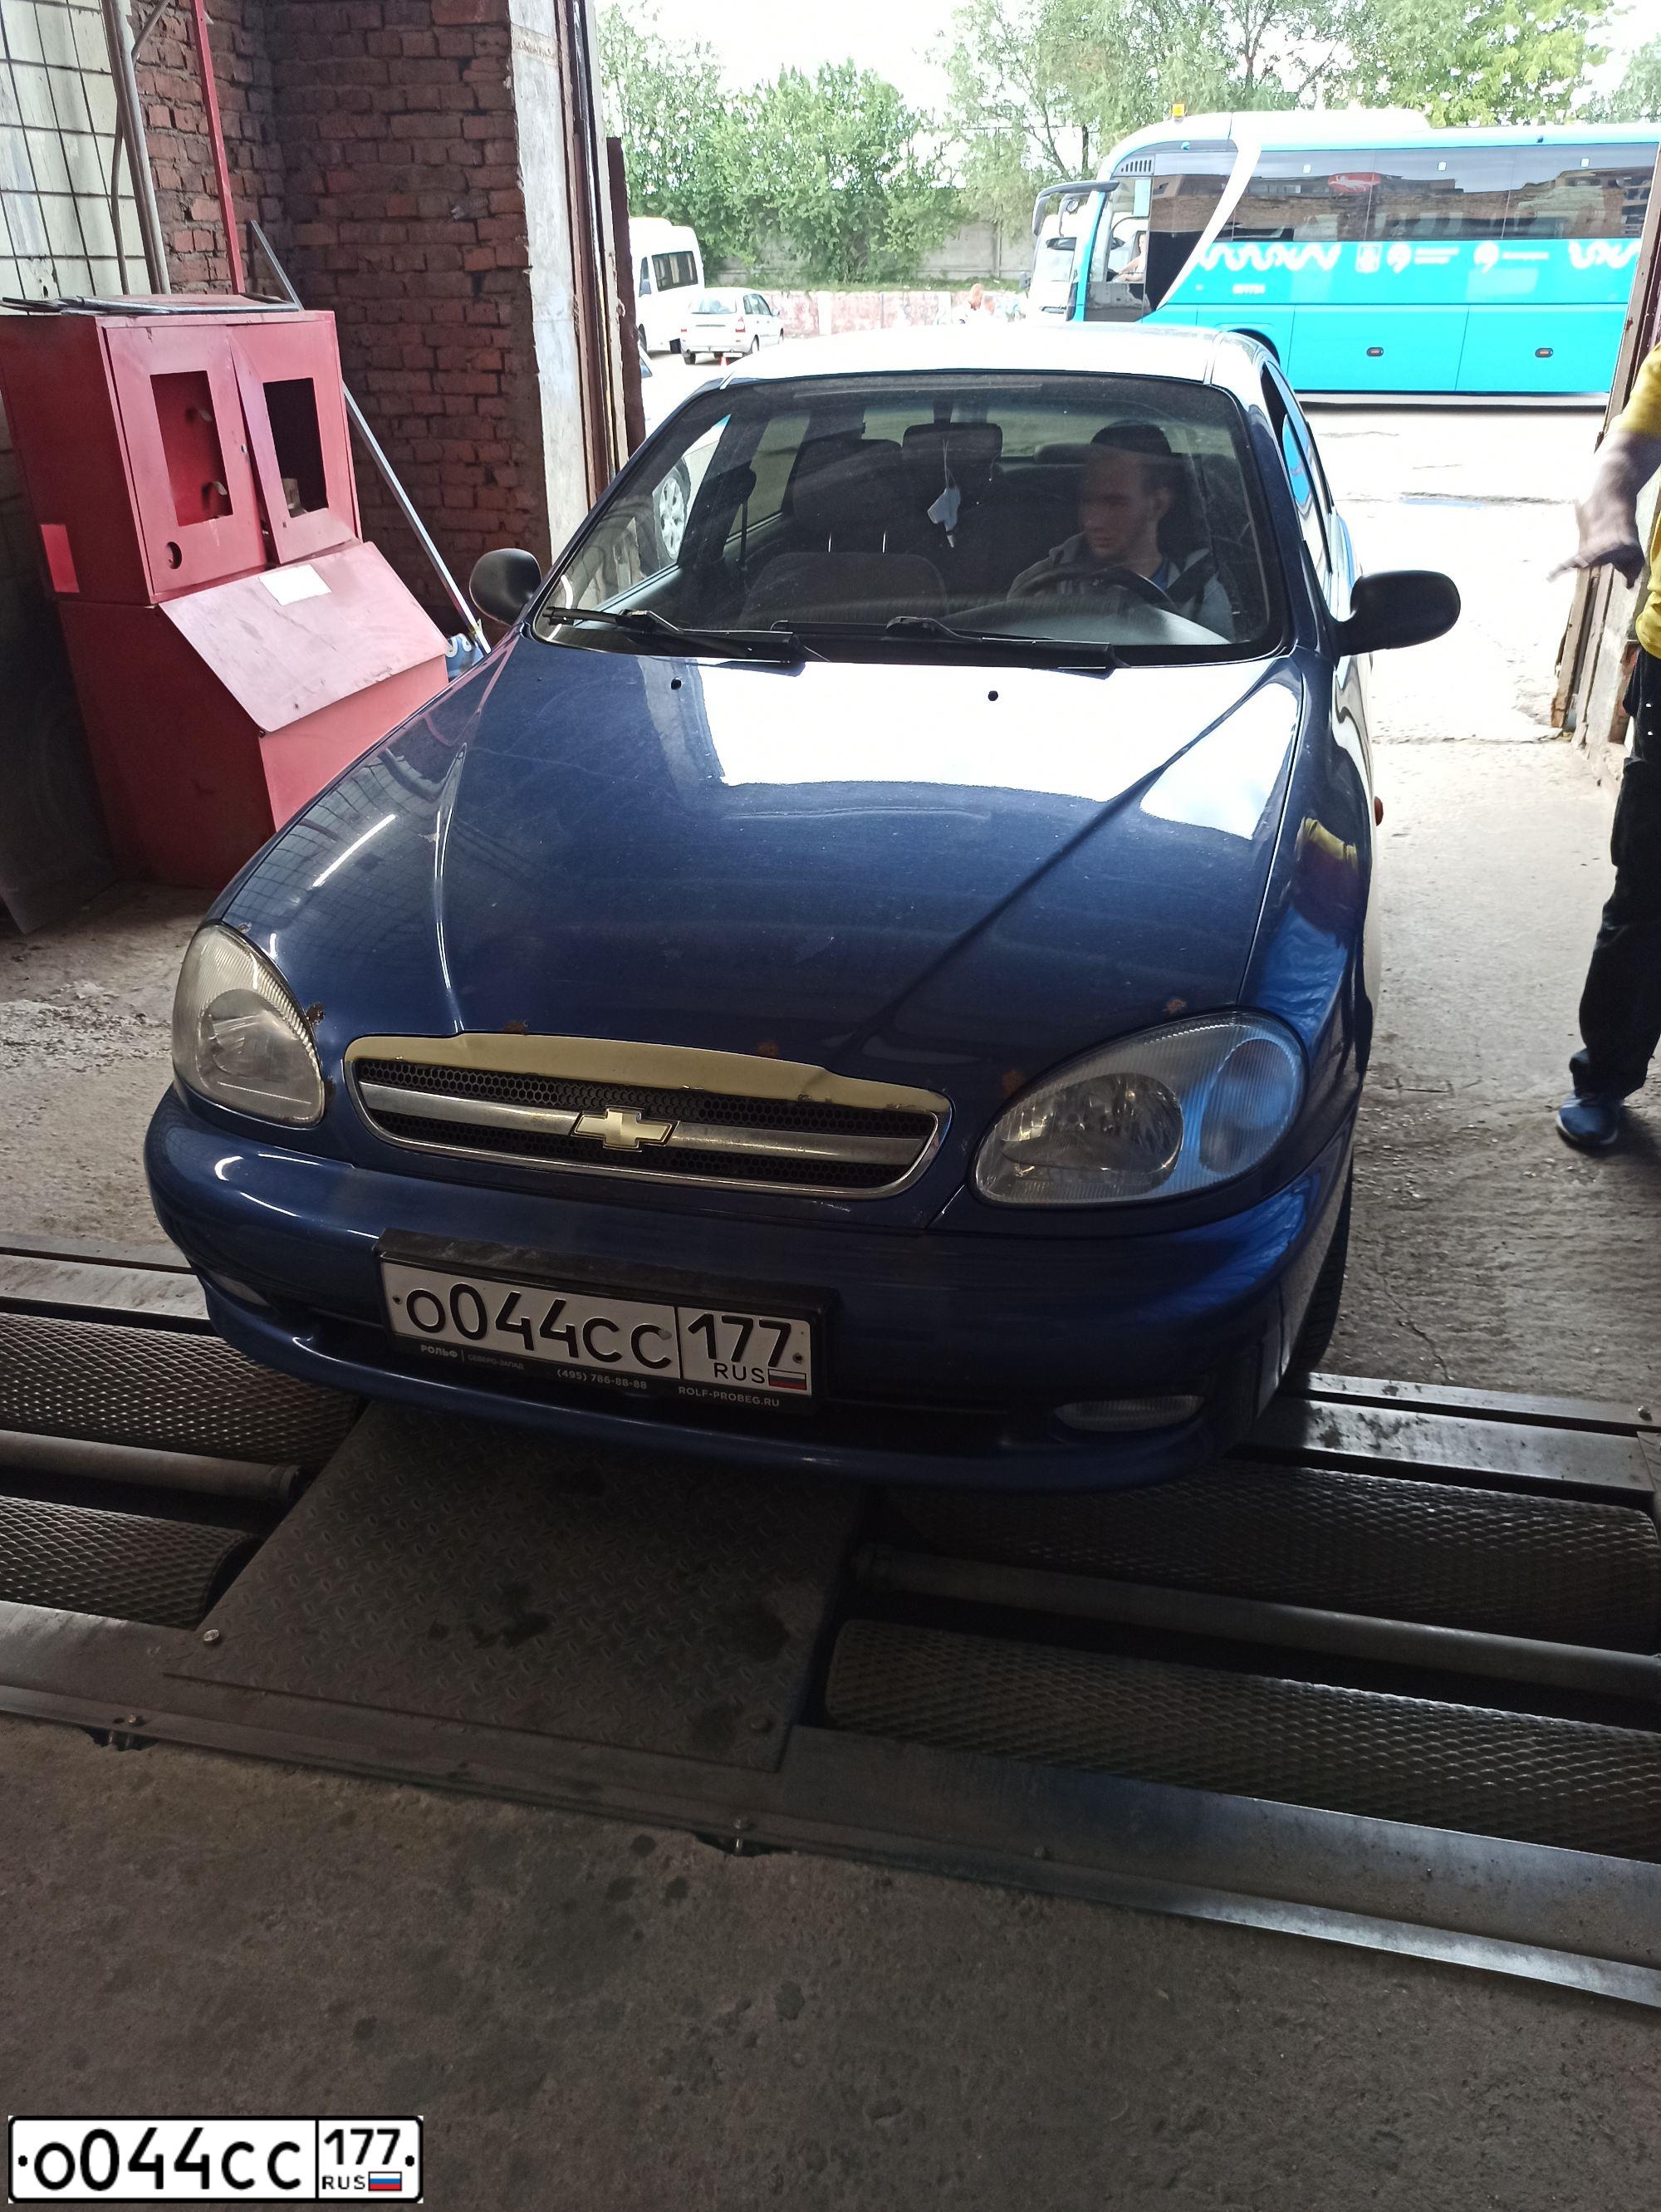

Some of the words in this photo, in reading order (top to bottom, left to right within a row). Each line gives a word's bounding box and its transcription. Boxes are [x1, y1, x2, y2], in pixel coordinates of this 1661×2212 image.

[688, 1313, 791, 1367] 177
[420, 1344, 458, 1358] РОЛЬФ
[556, 1369, 587, 1381] (495)
[713, 1362, 766, 1384] RUS
[678, 1386, 780, 1407] ROLF-PROBEG.RU
